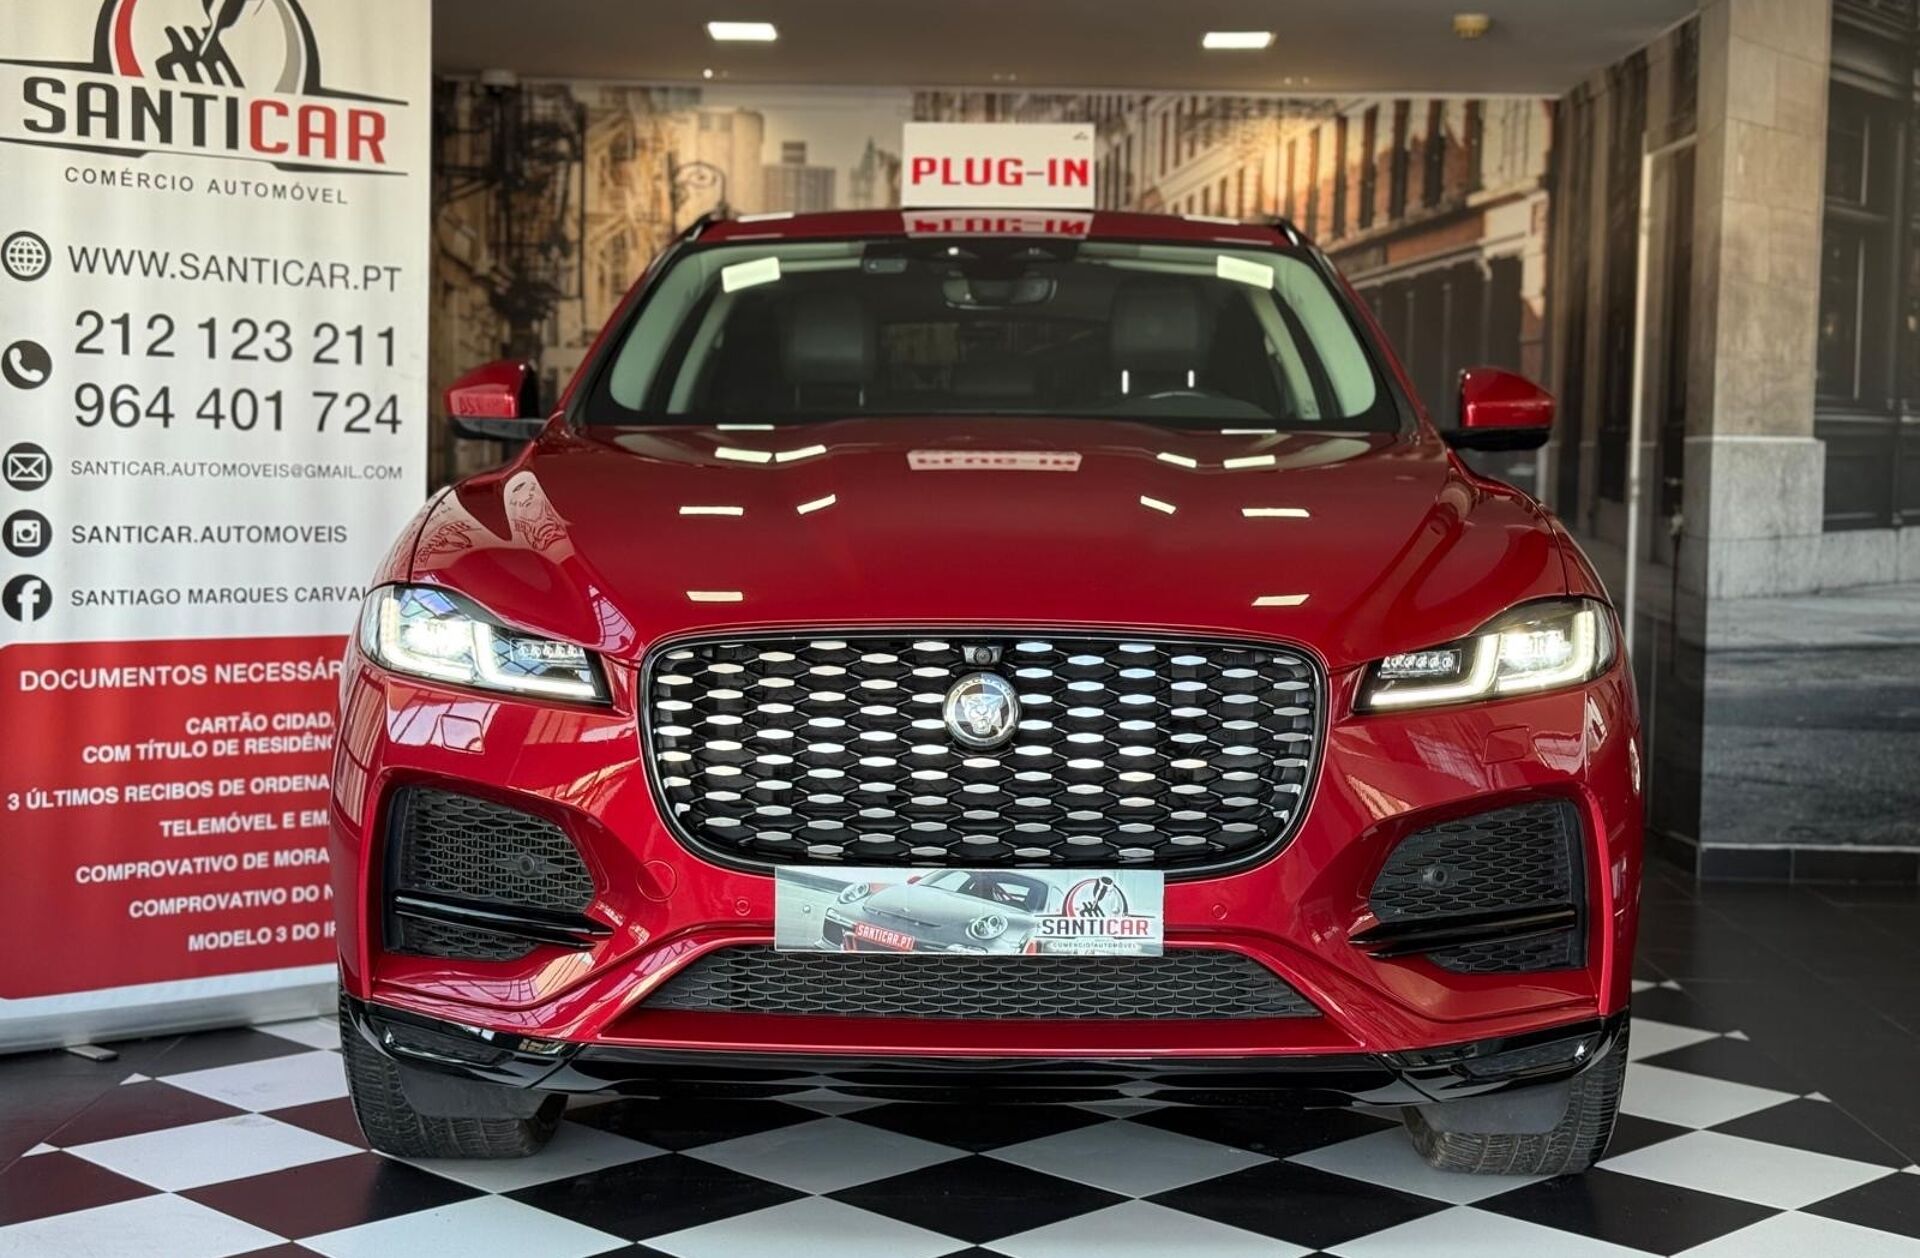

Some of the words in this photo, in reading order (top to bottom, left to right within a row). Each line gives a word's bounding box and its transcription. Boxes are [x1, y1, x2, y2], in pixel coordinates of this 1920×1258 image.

[23, 76, 386, 164] SANTICAR
[65, 167, 193, 191] COMÉRCIO
[207, 179, 347, 204] AUTOMÓVEL
[912, 157, 1089, 187] PLUG-IN
[68, 246, 401, 292] WWW.SANTICAR.PT
[75, 310, 174, 357] 212
[198, 317, 292, 362] 123
[313, 323, 393, 366] 211
[75, 383, 175, 428] 964
[196, 388, 281, 431] 401
[313, 391, 402, 434] 724
[71, 460, 402, 479] SANTICAR.AUTOMOVEIS@GMAIL.COM
[72, 525, 347, 543] SANTICAR.AUTOMOVEIS
[71, 589, 180, 606] SANTIAGO
[188, 587, 288, 603] MARQUES
[21, 665, 207, 691] DOCUMENTOS
[186, 713, 268, 735] CARTÃO
[272, 712, 334, 732] CIDAD
[83, 745, 130, 763] COM
[136, 739, 207, 760] TÍTULO
[213, 739, 239, 756] DE
[8, 793, 19, 810] 3
[26, 787, 119, 809] ÚLTIMOS
[125, 781, 213, 802] RECIBOS
[219, 779, 245, 796] DE
[160, 812, 277, 837] TELEMÓVEL
[283, 812, 295, 828] E
[300, 810, 330, 827] EM
[76, 854, 238, 883] COMPROVATIVO
[243, 852, 268, 869] DE
[274, 848, 330, 866] MORA
[129, 888, 287, 918] COMPROVATIVO
[292, 885, 319, 903] DO
[188, 927, 272, 951] MODELO
[276, 926, 287, 942] 3
[292, 923, 320, 941] DO
[1042, 919, 1149, 936] SANTICAR
